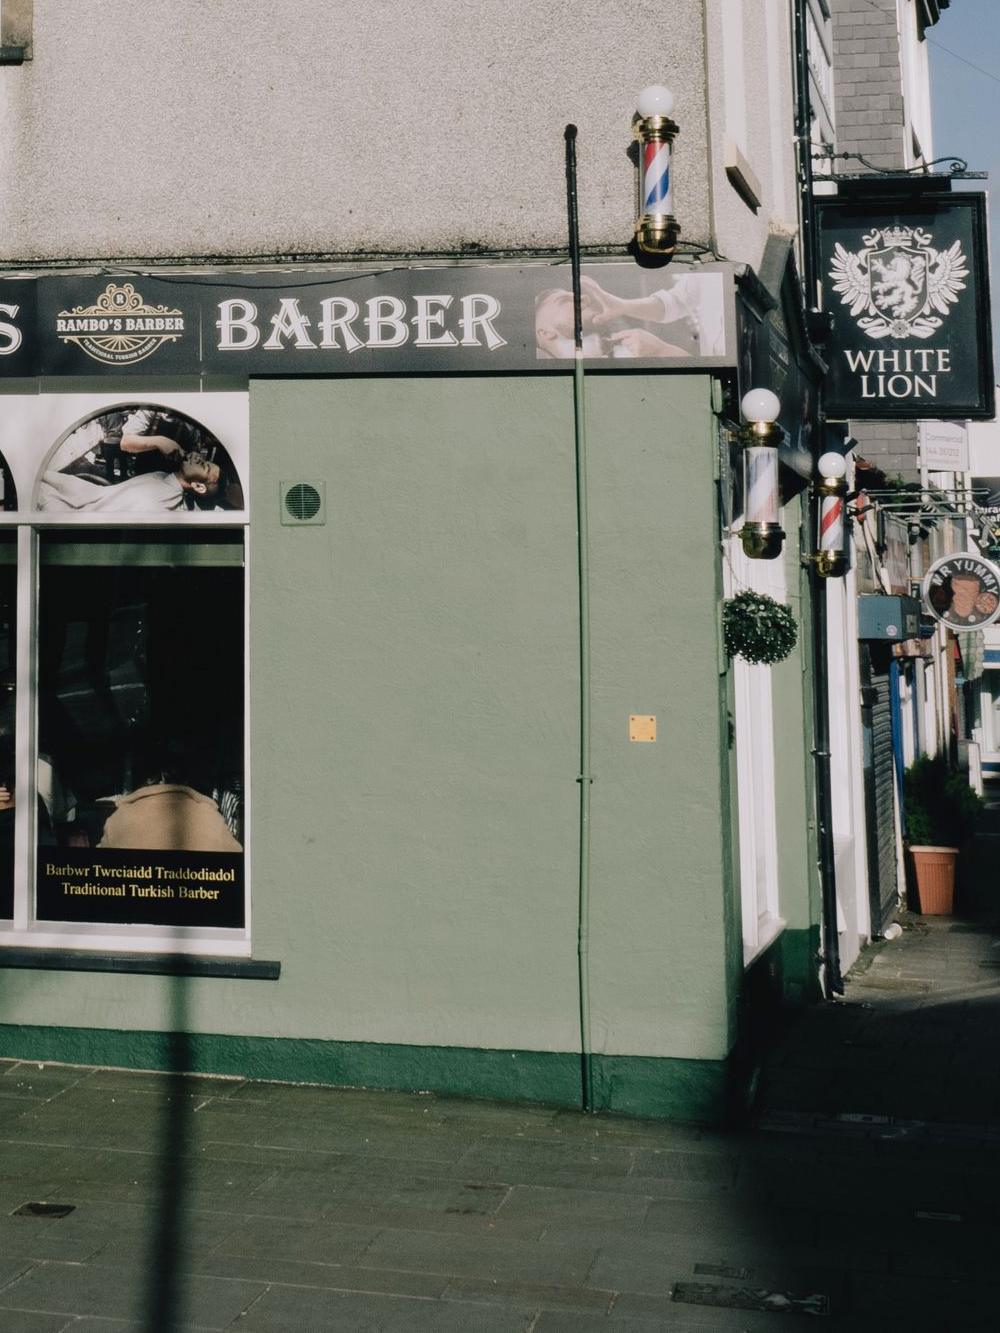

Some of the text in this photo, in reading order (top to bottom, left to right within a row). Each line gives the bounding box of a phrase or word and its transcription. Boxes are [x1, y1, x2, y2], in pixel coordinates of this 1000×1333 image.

[56, 317, 185, 332] RAMBO'S BARBER
[215, 294, 508, 353] BARBER
[844, 349, 951, 372] WHITE
[861, 374, 937, 398] LION
[932, 560, 999, 594] MR YUMMY
[46, 864, 235, 882] Barbwr Twrciaidd Traddodiadol
[61, 882, 220, 900] Traditional Turkish Barber
